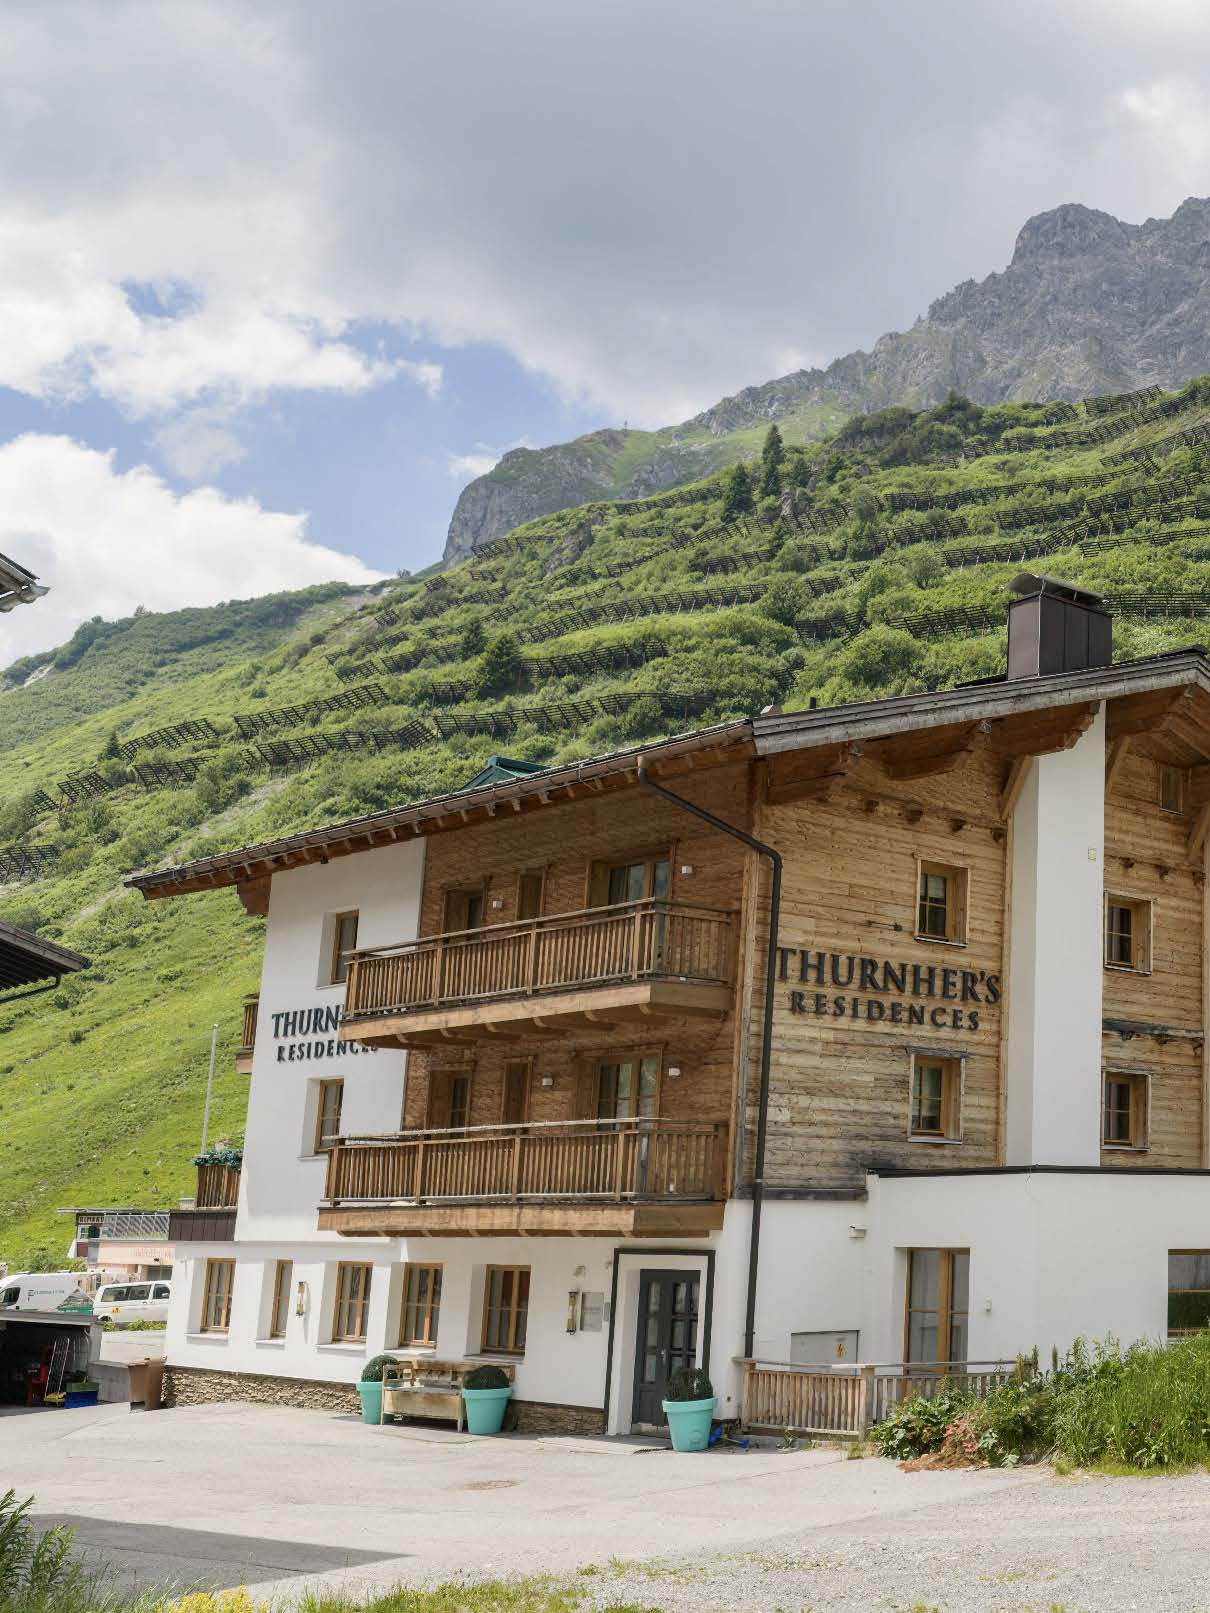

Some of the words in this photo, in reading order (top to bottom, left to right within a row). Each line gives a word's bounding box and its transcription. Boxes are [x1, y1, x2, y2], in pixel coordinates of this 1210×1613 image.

[776, 946, 1001, 1005] THURNHER'S
[271, 1004, 345, 1039] THURN
[790, 990, 980, 1031] RESIDENCES
[276, 1039, 378, 1062] RESIDENC
